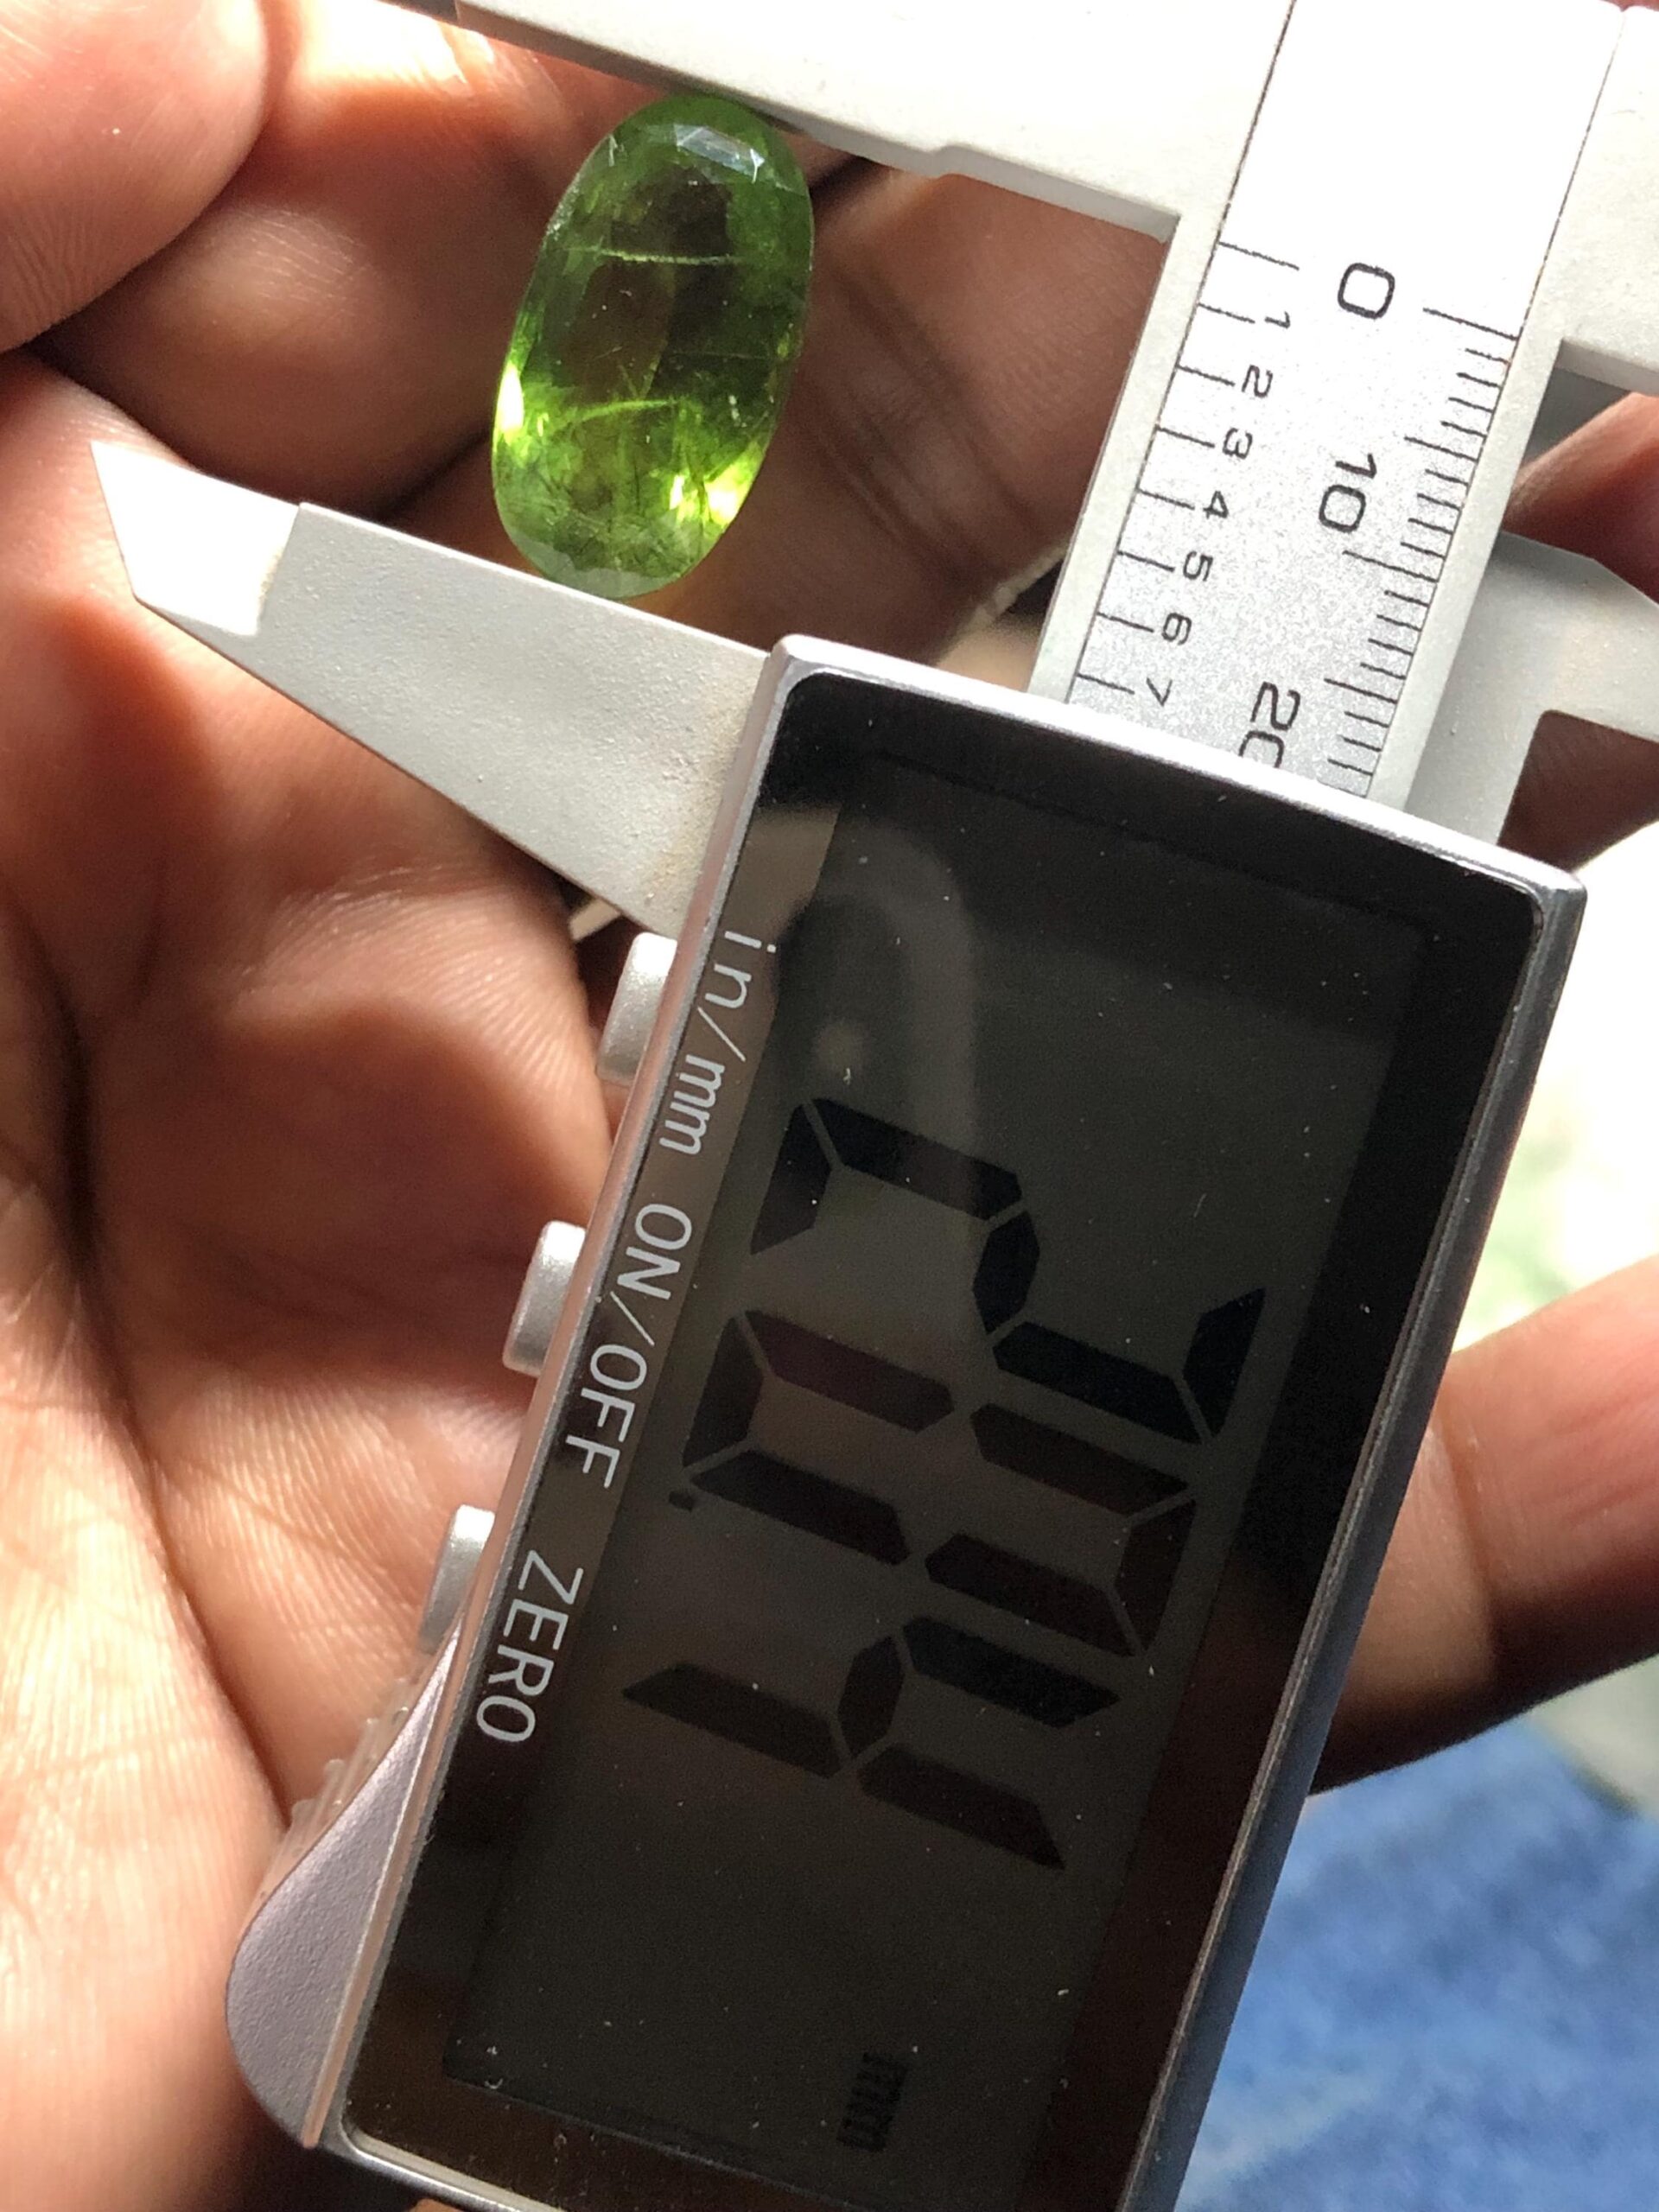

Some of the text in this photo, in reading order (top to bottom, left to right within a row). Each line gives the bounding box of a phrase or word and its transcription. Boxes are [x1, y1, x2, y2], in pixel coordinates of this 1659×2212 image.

[1145, 309, 1292, 707] 1 2 3 4 5 6 7
[1238, 262, 1395, 768] 0 10 20
[474, 929, 777, 1745] in/mm ON/OFF ZERO
[622, 1097, 1267, 1872] 20.4
